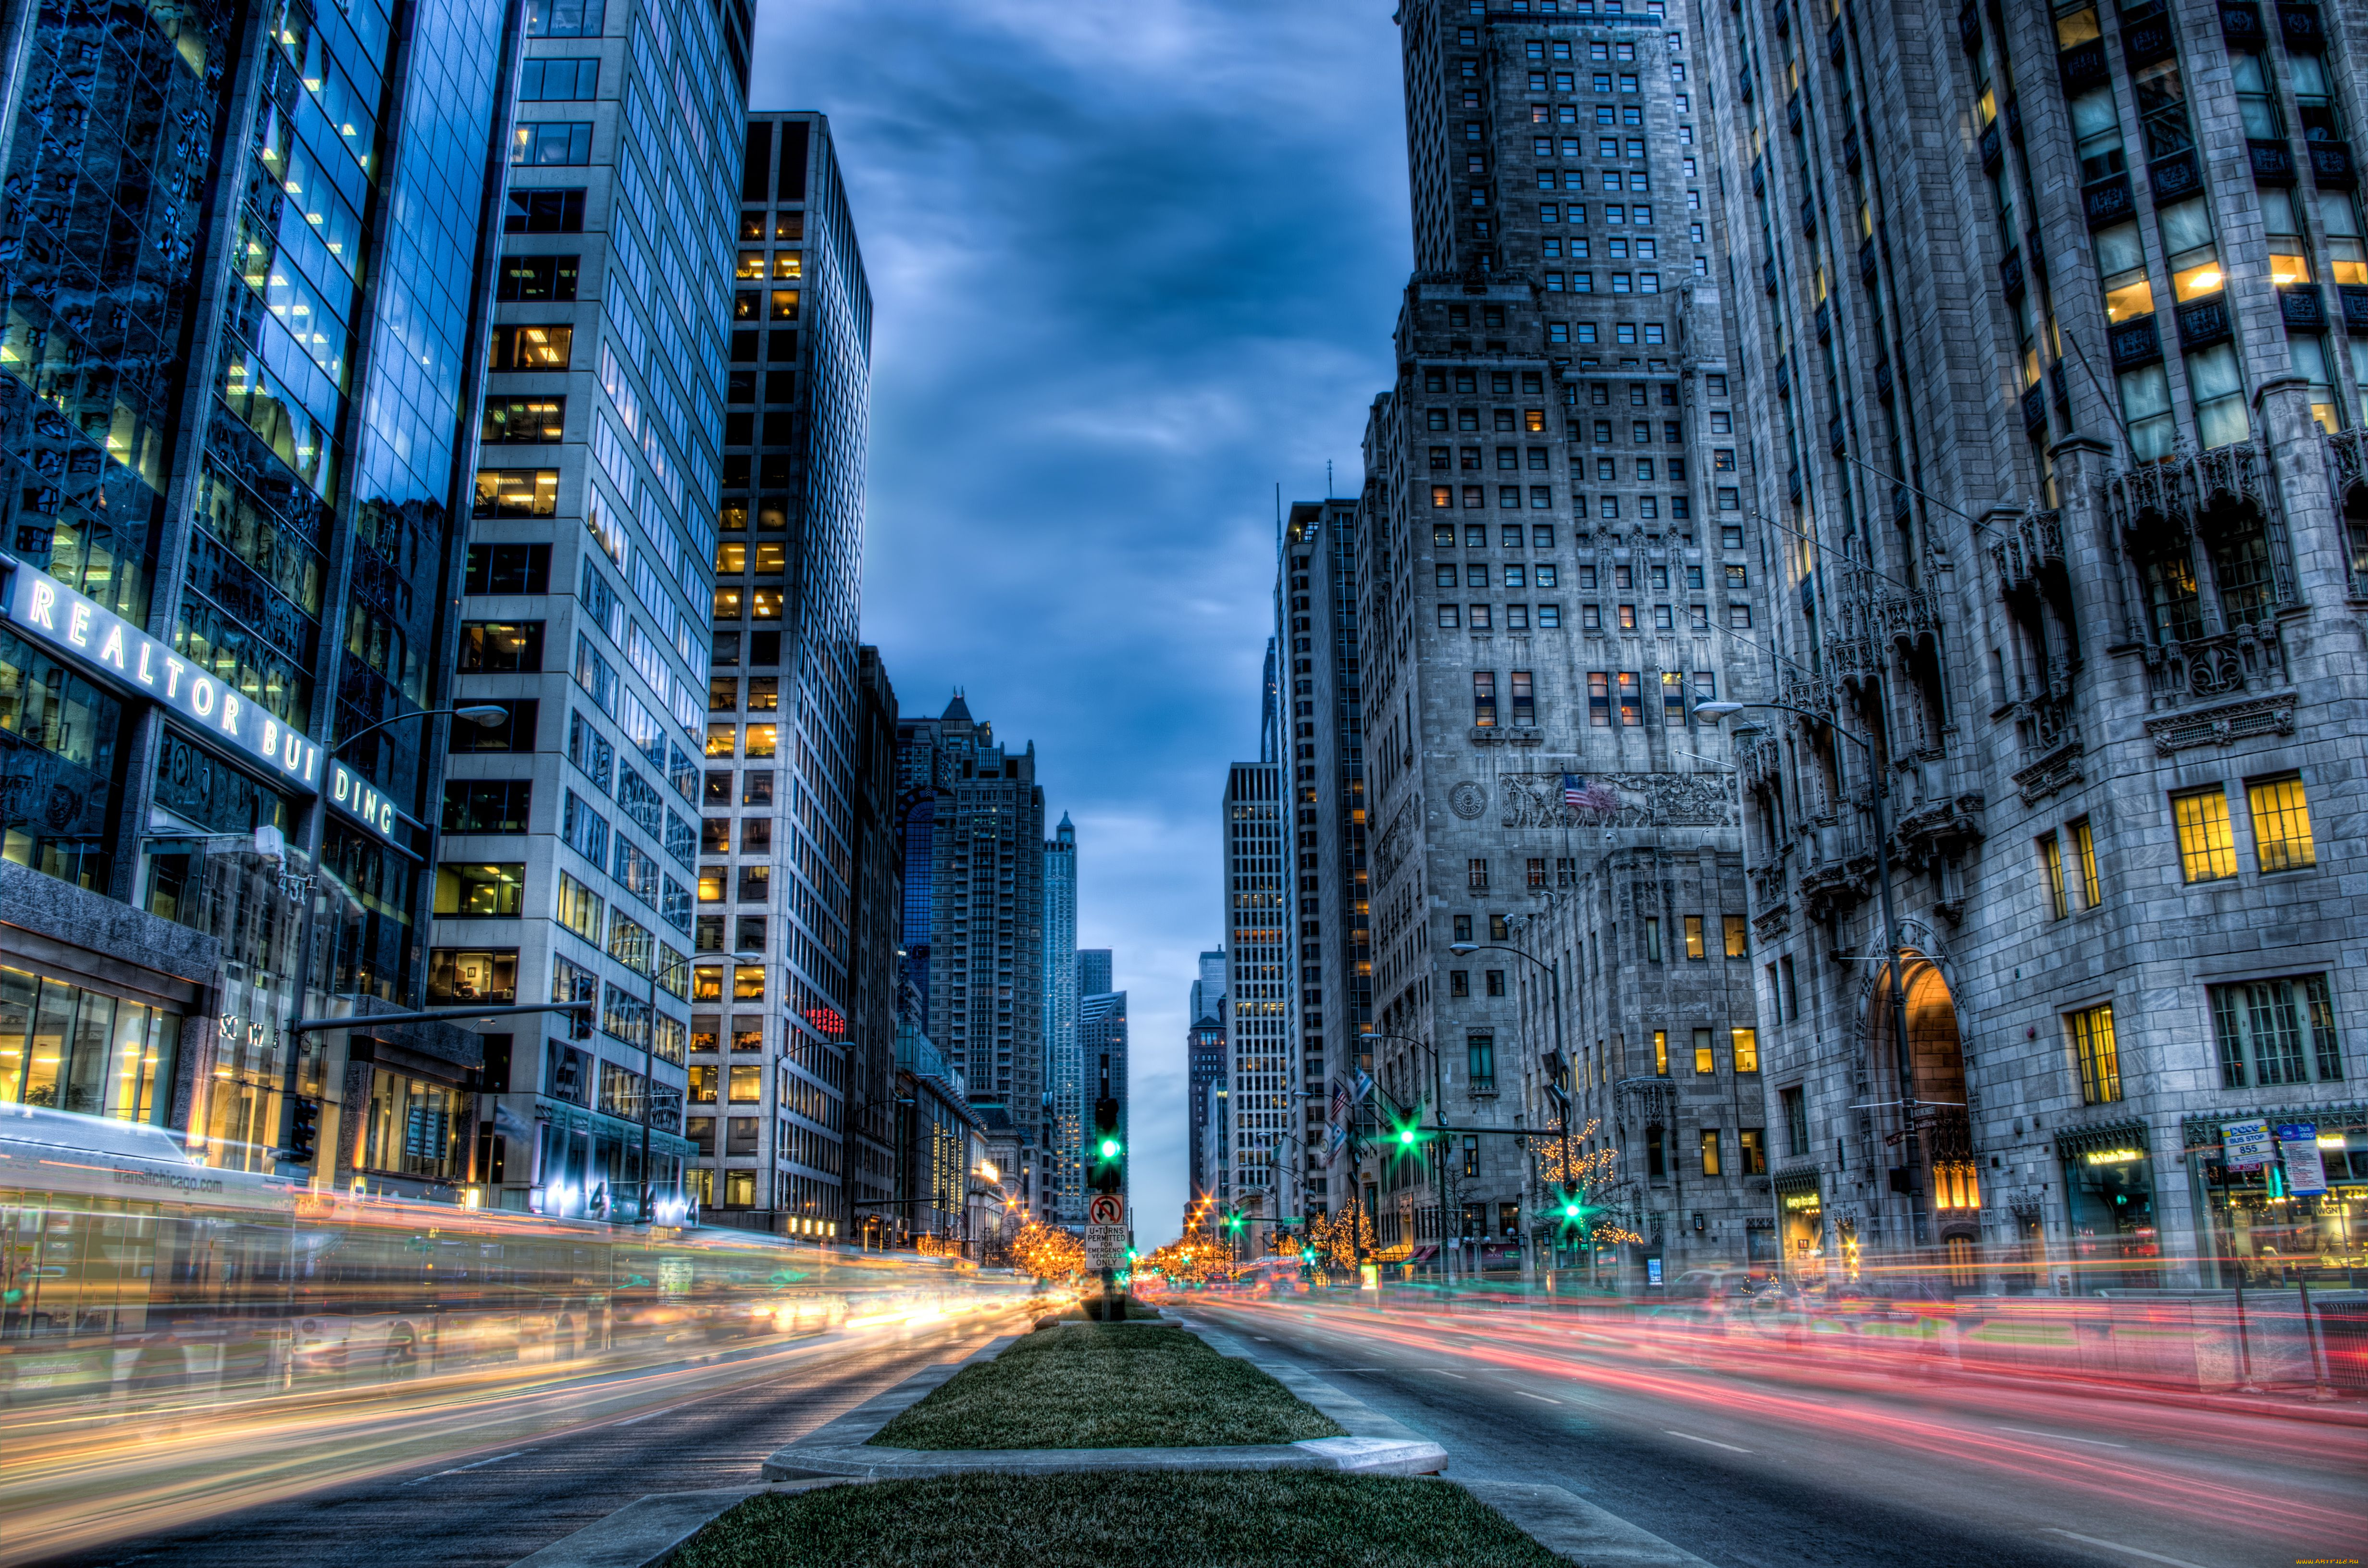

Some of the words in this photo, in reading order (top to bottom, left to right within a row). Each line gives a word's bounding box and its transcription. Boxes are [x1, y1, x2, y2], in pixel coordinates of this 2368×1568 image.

[31, 579, 239, 736] REALTOR
[263, 720, 393, 834] BUIDING
[219, 1013, 281, 1049] SCWB
[2230, 1124, 2259, 1136] pace
[2240, 1145, 2258, 1154] 855
[114, 1164, 222, 1195] transitchicago.com
